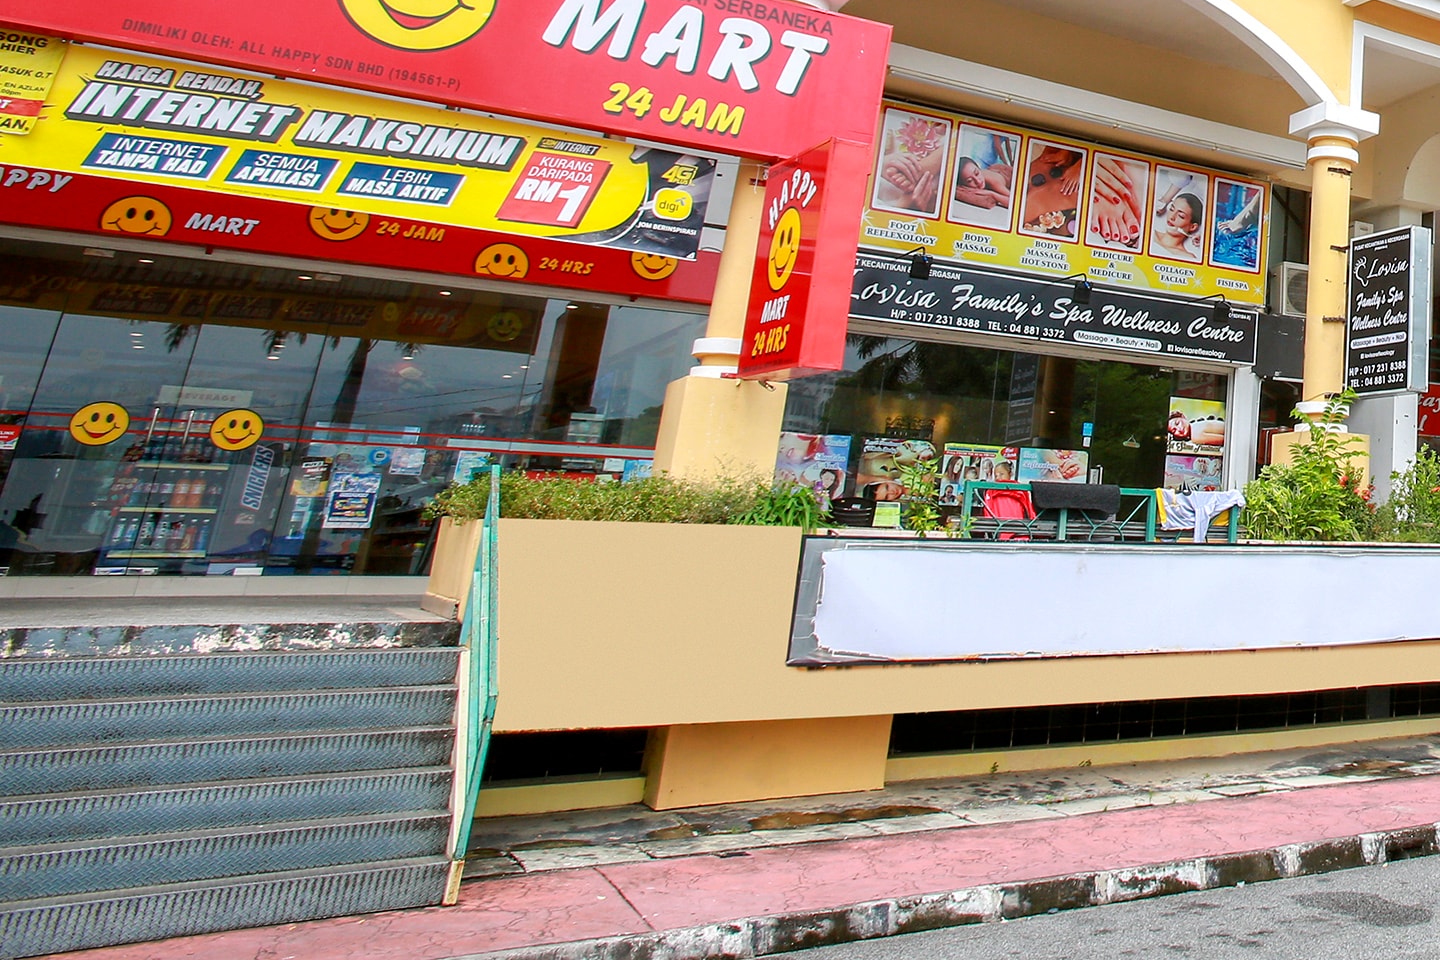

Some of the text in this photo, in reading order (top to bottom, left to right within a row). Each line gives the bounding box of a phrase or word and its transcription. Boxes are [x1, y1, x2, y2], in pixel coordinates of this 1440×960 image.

[0, 42, 36, 55] HIER
[121, 18, 187, 41] DIMILIKI
[190, 30, 234, 49] OLEH:
[239, 40, 266, 56] ALL
[269, 45, 322, 65] HAPPY
[325, 54, 353, 71] SDN
[357, 60, 385, 77] BHD
[95, 60, 264, 101] HARGA RENDAH,
[602, 81, 746, 136] 24 JAM
[66, 81, 526, 169] INTERNET MAKSIMUM
[111, 137, 214, 160] INTERNET
[96, 150, 209, 176] TANPA HAD
[254, 153, 320, 172] SEMUA
[538, 156, 594, 173] KURANG
[0, 166, 73, 193] PPY
[234, 166, 322, 188] APLIKASI
[383, 168, 432, 185] LEBIH
[527, 166, 593, 184] DARIPADA
[661, 164, 698, 184] 4G
[345, 178, 398, 199] MASA
[398, 184, 450, 202] AKTIF
[768, 168, 817, 231] HAPPY
[659, 200, 680, 213] digi
[184, 212, 260, 236] MART
[375, 221, 446, 242] 24 JAM
[637, 221, 697, 236] JOM BERINSPIRASI
[889, 220, 918, 232] FOOT
[865, 226, 937, 246] REFLEXOLOGY
[963, 233, 990, 244] BODY
[1034, 240, 1061, 251] BODY
[954, 241, 998, 255] MASSAGE
[1026, 248, 1066, 261] MASSAGE
[1092, 250, 1134, 263] PEDICURE
[538, 256, 594, 275] 24 HRS
[861, 259, 907, 273] KECANTIKAN
[1020, 256, 1070, 271] HOT STONE
[1153, 264, 1195, 277] COLLAGEN
[1366, 257, 1409, 279] Lovisa
[1088, 267, 1133, 281] MEDICURE
[1160, 274, 1188, 285] FACIAL
[1216, 278, 1249, 290] FISH SPA
[1356, 286, 1405, 312] Family's Spa
[760, 295, 790, 324] MART
[951, 283, 1044, 321] Family's
[1049, 297, 1094, 331] Spa
[1101, 304, 1182, 336] Wellness
[1186, 317, 1246, 344] Centre
[890, 308, 1066, 339] H/P 017 231 8388 TEL 04 881 3372
[1351, 309, 1408, 332] Wellness Centre
[752, 323, 791, 357] 24 HRS
[1077, 331, 1109, 344] Massage
[1116, 337, 1139, 348] Beauty
[1145, 341, 1159, 350] Nail
[1363, 360, 1407, 376] 017 231 8388
[1387, 373, 1404, 384] 3372
[242, 445, 274, 510] SNICKERS
